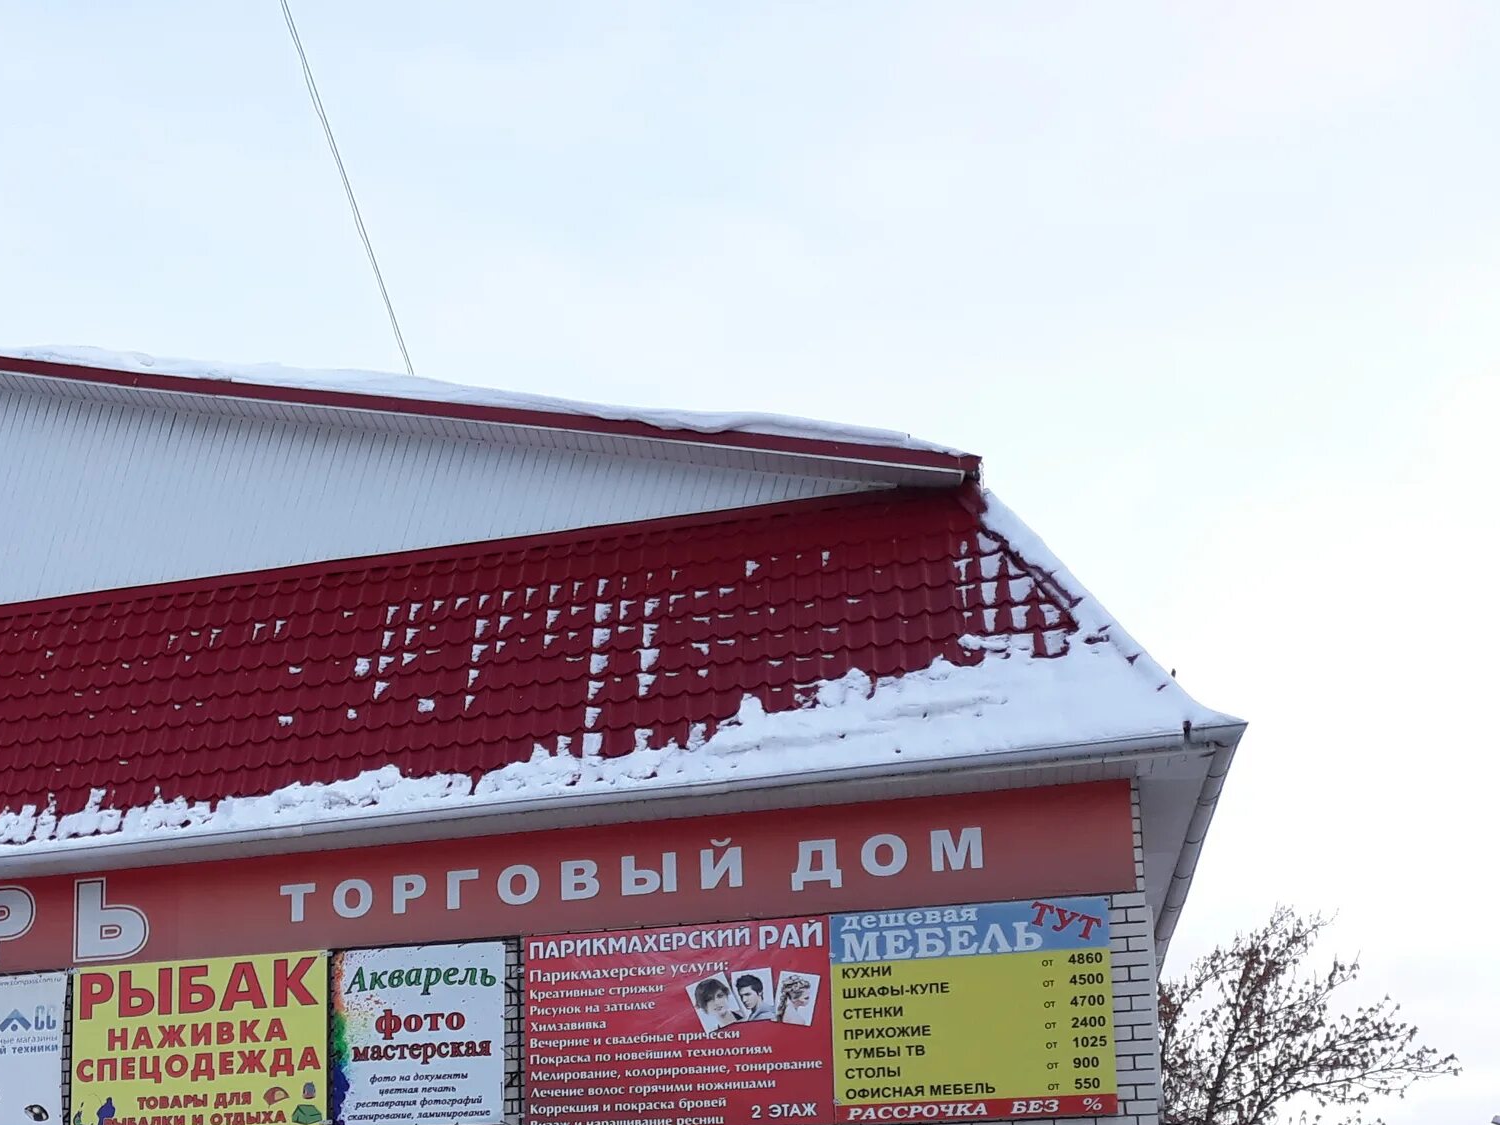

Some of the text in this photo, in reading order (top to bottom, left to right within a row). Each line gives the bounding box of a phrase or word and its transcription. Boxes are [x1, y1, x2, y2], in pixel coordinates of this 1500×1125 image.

[280, 826, 984, 921] ТОРГОВЫЙ ДОМ
[841, 907, 978, 931] дешевая
[1031, 901, 1101, 940] ТУТ
[530, 920, 823, 960] ПАРИКМАХЕРСКИЙ РАЙ
[841, 921, 1043, 962] МЕБЕЛЬ
[1068, 952, 1103, 965] 4860
[530, 960, 729, 983] Парикмахерские услуги:
[842, 966, 892, 978] КУХНИ
[1069, 973, 1104, 985] 4500
[79, 956, 318, 1020] РЫБАК
[345, 966, 496, 995] Акварель
[530, 983, 663, 1000] Креативные стрижки
[842, 982, 950, 999] ШКАФЫ-КУПЕ
[1070, 994, 1105, 1007] 4700
[843, 1006, 903, 1020] СТЕНКИ
[375, 1009, 465, 1040] фото
[530, 1019, 606, 1032] Химзавивка
[1071, 1016, 1106, 1028] 2400
[108, 1018, 287, 1051] НАЖИВКА
[844, 1025, 931, 1040] ПРИХОЖИЕ
[12, 1044, 58, 1054] техники
[1073, 1035, 1107, 1048] 1025
[352, 1040, 491, 1065] мастерская
[845, 1045, 925, 1060] ТУМБЫ ТВ
[76, 1047, 321, 1083] СПЕЦОДЕЖДА
[1073, 1057, 1099, 1069] 900
[369, 1074, 396, 1085] фото
[413, 1072, 468, 1082] документы
[845, 1066, 901, 1080] СТОЛЫ
[846, 1083, 996, 1100] ОФИСНАЯ МЕБЕЛЬ
[1075, 1078, 1100, 1089] 550
[137, 1092, 251, 1110] ТОВАРЫ ДЛЯ
[847, 1097, 1102, 1121] РАССРОЧКА БЕЗ %
[752, 1103, 817, 1118] 2 ЭТАЖ
